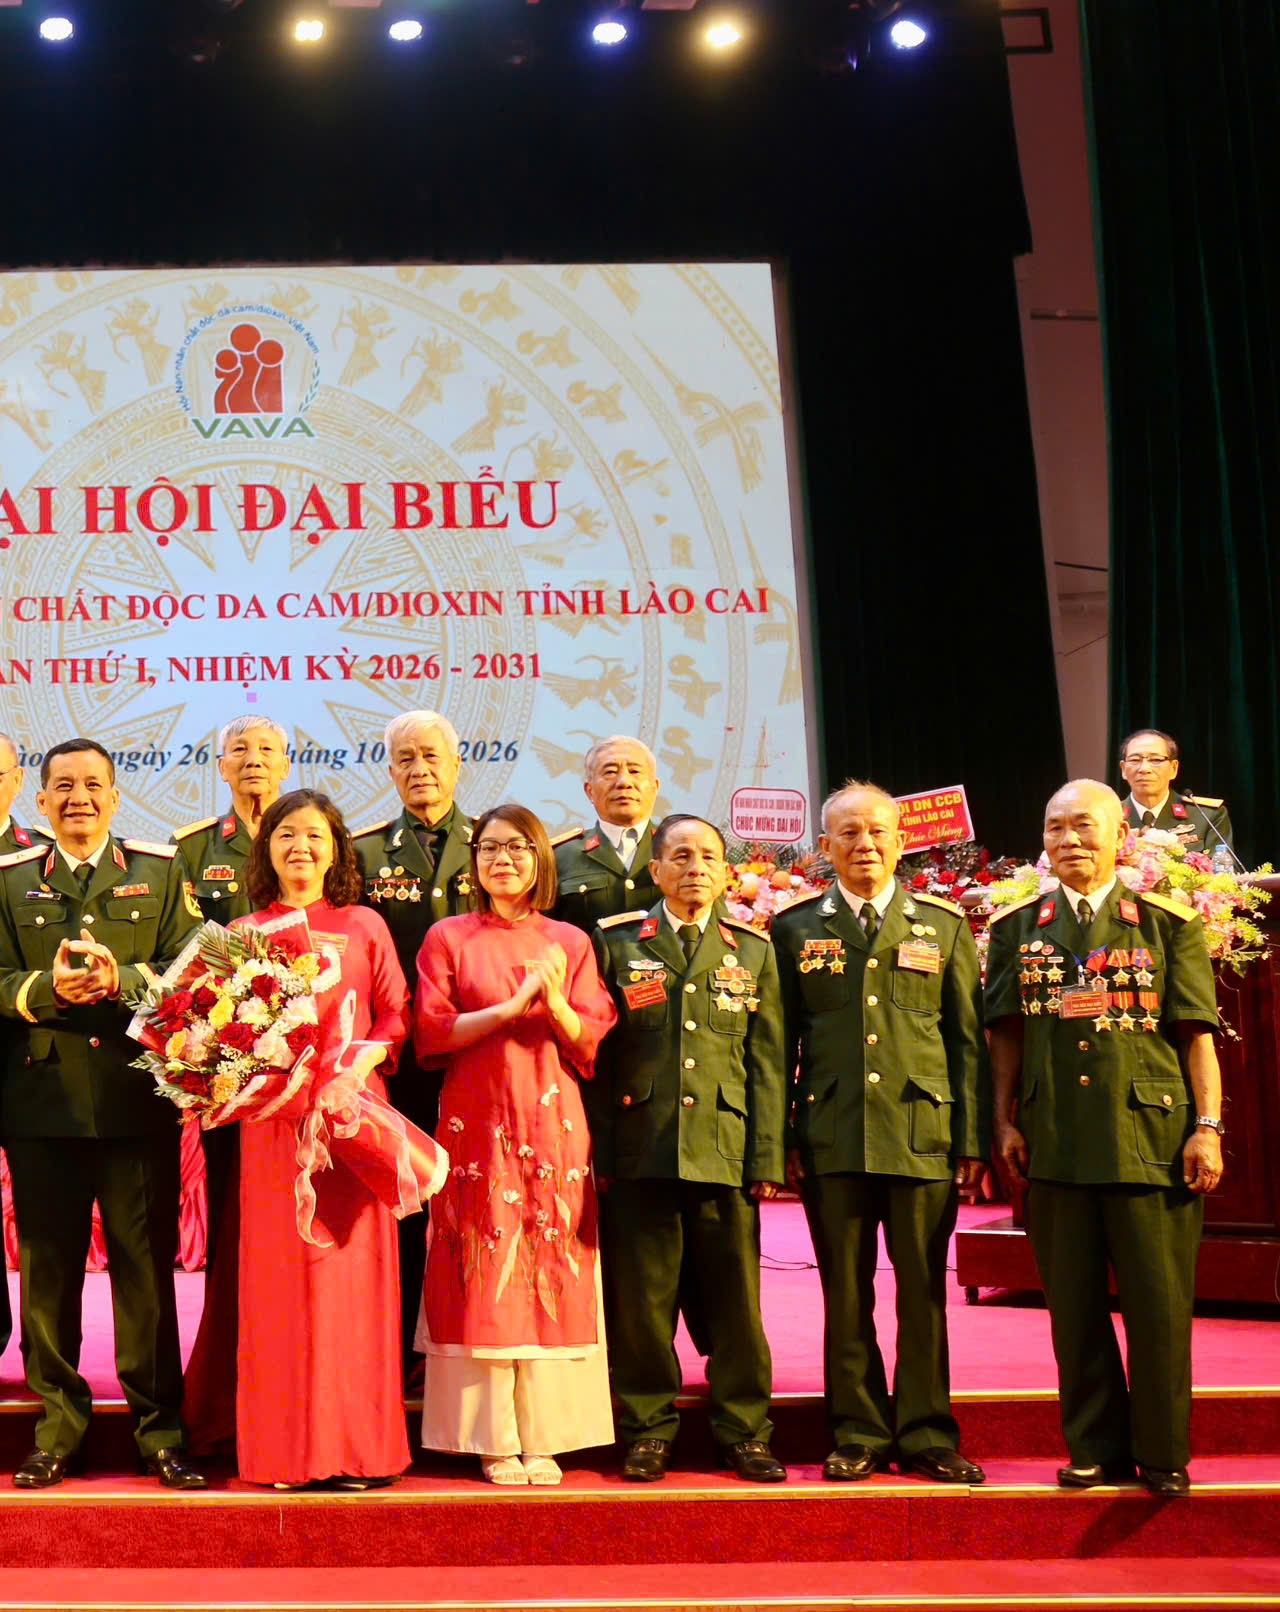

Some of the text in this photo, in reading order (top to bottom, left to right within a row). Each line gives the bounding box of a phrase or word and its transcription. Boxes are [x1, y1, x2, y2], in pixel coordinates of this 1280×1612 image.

[192, 417, 315, 438] VAVA
[80, 477, 216, 547] HỘI
[237, 482, 368, 545] ĐẠI
[387, 465, 562, 530] BIỂU
[13, 588, 117, 623] CHẤT
[127, 590, 206, 627] ĐỘC
[216, 593, 267, 619] DA
[277, 591, 504, 619] CAM/DIOXIN
[516, 583, 606, 617] TỈNH
[618, 581, 696, 615] LÀO
[705, 587, 769, 614] CAI
[44, 650, 127, 685] THỨ
[136, 657, 157, 688] I,
[168, 652, 291, 689] NHIỆM
[306, 646, 359, 681] KỲ
[370, 654, 441, 681] 2026
[473, 653, 541, 680] 2031
[178, 743, 210, 766] 26
[285, 741, 347, 771] háng
[354, 741, 386, 764] 10
[458, 739, 519, 763] 2026
[913, 798, 932, 811] DN
[935, 792, 962, 807] CCB
[939, 808, 955, 820] CAI
